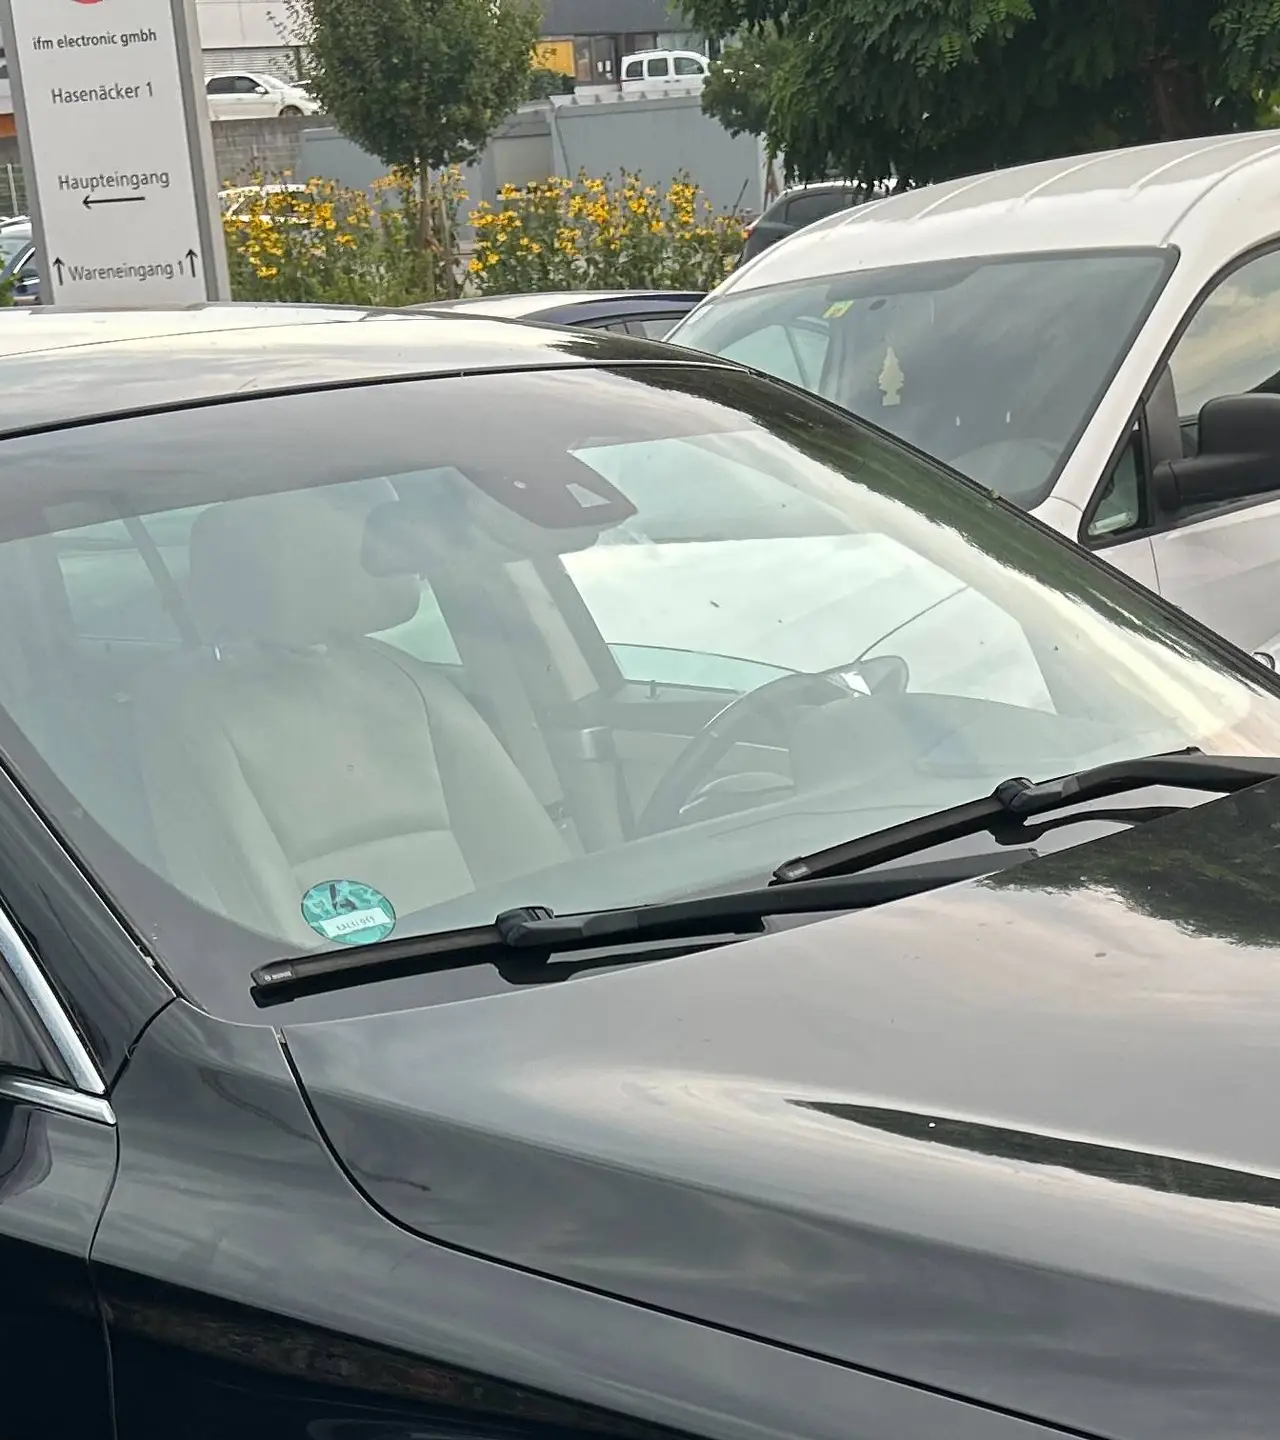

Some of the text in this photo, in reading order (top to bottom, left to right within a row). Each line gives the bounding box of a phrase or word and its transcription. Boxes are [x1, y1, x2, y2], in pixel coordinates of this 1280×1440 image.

[31, 28, 157, 50] ifm electronic gmbh
[51, 81, 154, 104] Hasenäcker 1
[58, 171, 170, 192] Haupteingang
[67, 260, 184, 281] Wareneingang 1
